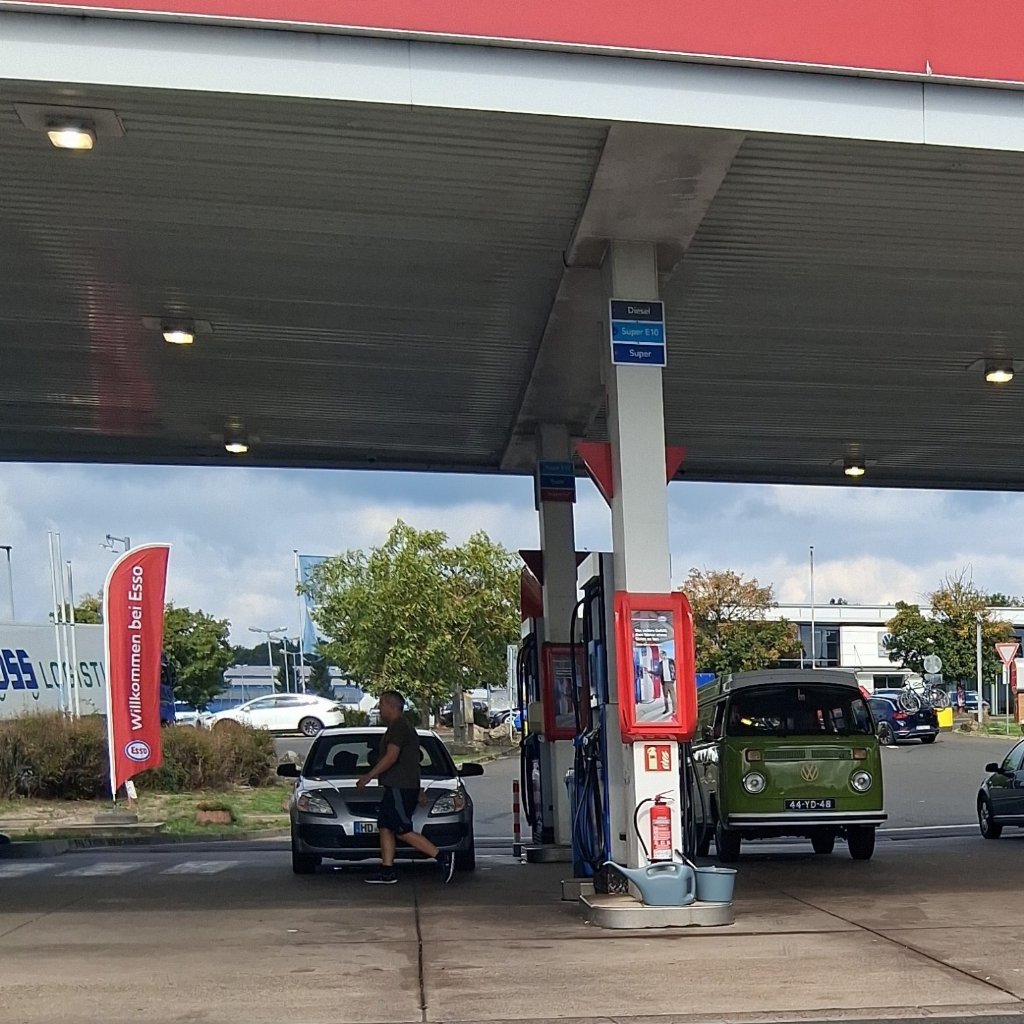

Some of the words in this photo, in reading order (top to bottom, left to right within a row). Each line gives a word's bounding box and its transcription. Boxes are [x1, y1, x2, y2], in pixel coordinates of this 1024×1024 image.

[627, 306, 651, 315] Diesel
[621, 327, 643, 337] Super
[644, 328, 660, 337] E10
[629, 348, 652, 359] Super
[128, 566, 144, 602] Esso
[128, 606, 143, 630] bei
[128, 634, 143, 730] Willkommen
[789, 800, 832, 809] 44-YD-48
